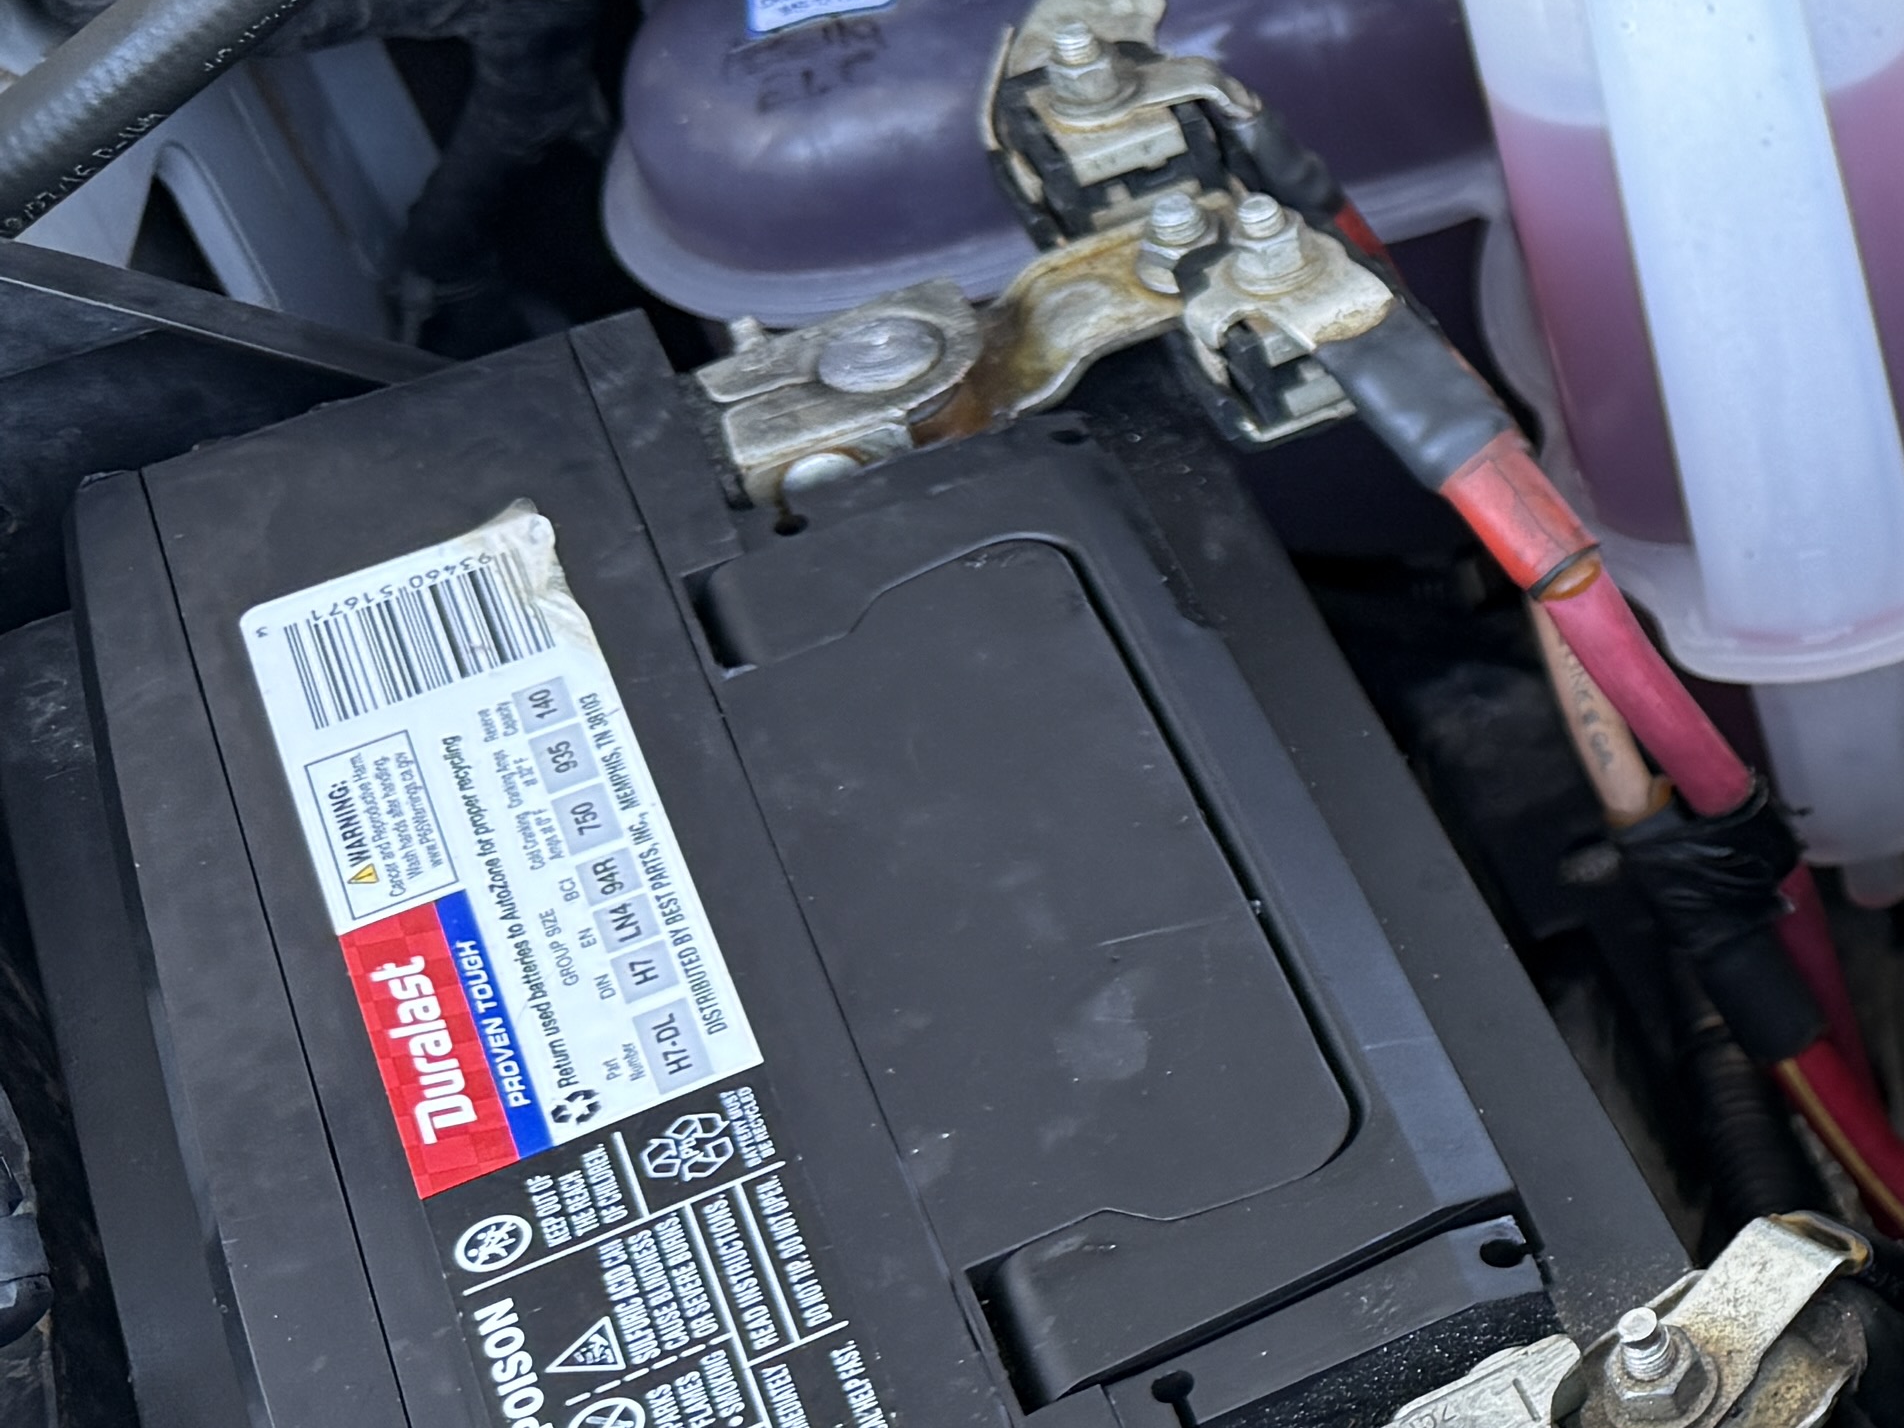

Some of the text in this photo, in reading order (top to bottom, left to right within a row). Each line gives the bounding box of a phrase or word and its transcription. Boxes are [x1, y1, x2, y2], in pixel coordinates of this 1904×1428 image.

[308, 549, 494, 622] 93460 51671
[473, 706, 500, 744] Reserve
[492, 699, 523, 738] Capacity
[526, 686, 560, 721] 140
[576, 690, 610, 731] 38103
[545, 737, 580, 775] 935
[591, 727, 617, 750] TN
[488, 747, 527, 810] Cranking Amps
[520, 776, 539, 789] at
[597, 745, 643, 812] MEMPHIS,
[324, 778, 373, 868] WARNING:
[353, 778, 392, 843] Reproductive
[382, 796, 405, 821] after
[537, 823, 556, 837] at
[568, 798, 603, 836] 750
[373, 840, 396, 863] and
[389, 817, 415, 851] hands
[510, 809, 546, 872] Cold Cranking
[540, 832, 568, 863] Amps
[380, 860, 407, 899] Cancer
[399, 847, 425, 880] Wash
[589, 854, 626, 897] 94R
[635, 841, 674, 892] PARTS,
[557, 875, 581, 903] BCI
[653, 887, 686, 926] BEST
[437, 732, 580, 1091] Return used batteries to AutoZone for proper recycling
[606, 899, 644, 943] LN4
[537, 906, 581, 988] GROUP SIZE
[575, 925, 598, 949] EN
[667, 923, 694, 947] BY
[592, 971, 617, 1001] DIN
[626, 953, 660, 987] H7
[675, 943, 729, 1036] DISTRIBUTED
[453, 933, 532, 1111] PROVEN TOUGH
[648, 1011, 693, 1076] H7-DL
[367, 949, 480, 1147] Duralast
[600, 1056, 623, 1081] Part
[616, 1039, 647, 1082] Number
[717, 1086, 763, 1169] BATTERY MUST
[735, 1083, 777, 1159] BE RECYCLED
[677, 1134, 701, 1160] Pb
[555, 1167, 601, 1238] THE REACH
[578, 1141, 629, 1226] OF CHILDREN.
[524, 1169, 573, 1249] KEEP OUT OF
[699, 1192, 780, 1352] READ INSTRUCTIONS.
[752, 1173, 834, 1329] DO NOT TIP. DO NOT OPEN.
[624, 1226, 691, 1353] CAUSE BLINDNESS
[652, 1210, 720, 1340] OR SEVERE BURNS.
[595, 1236, 662, 1367] SULFURIC ACID CAN
[827, 1338, 866, 1382] FAST.
[698, 1346, 746, 1420] SMOKING
[840, 1371, 879, 1415] HELP
